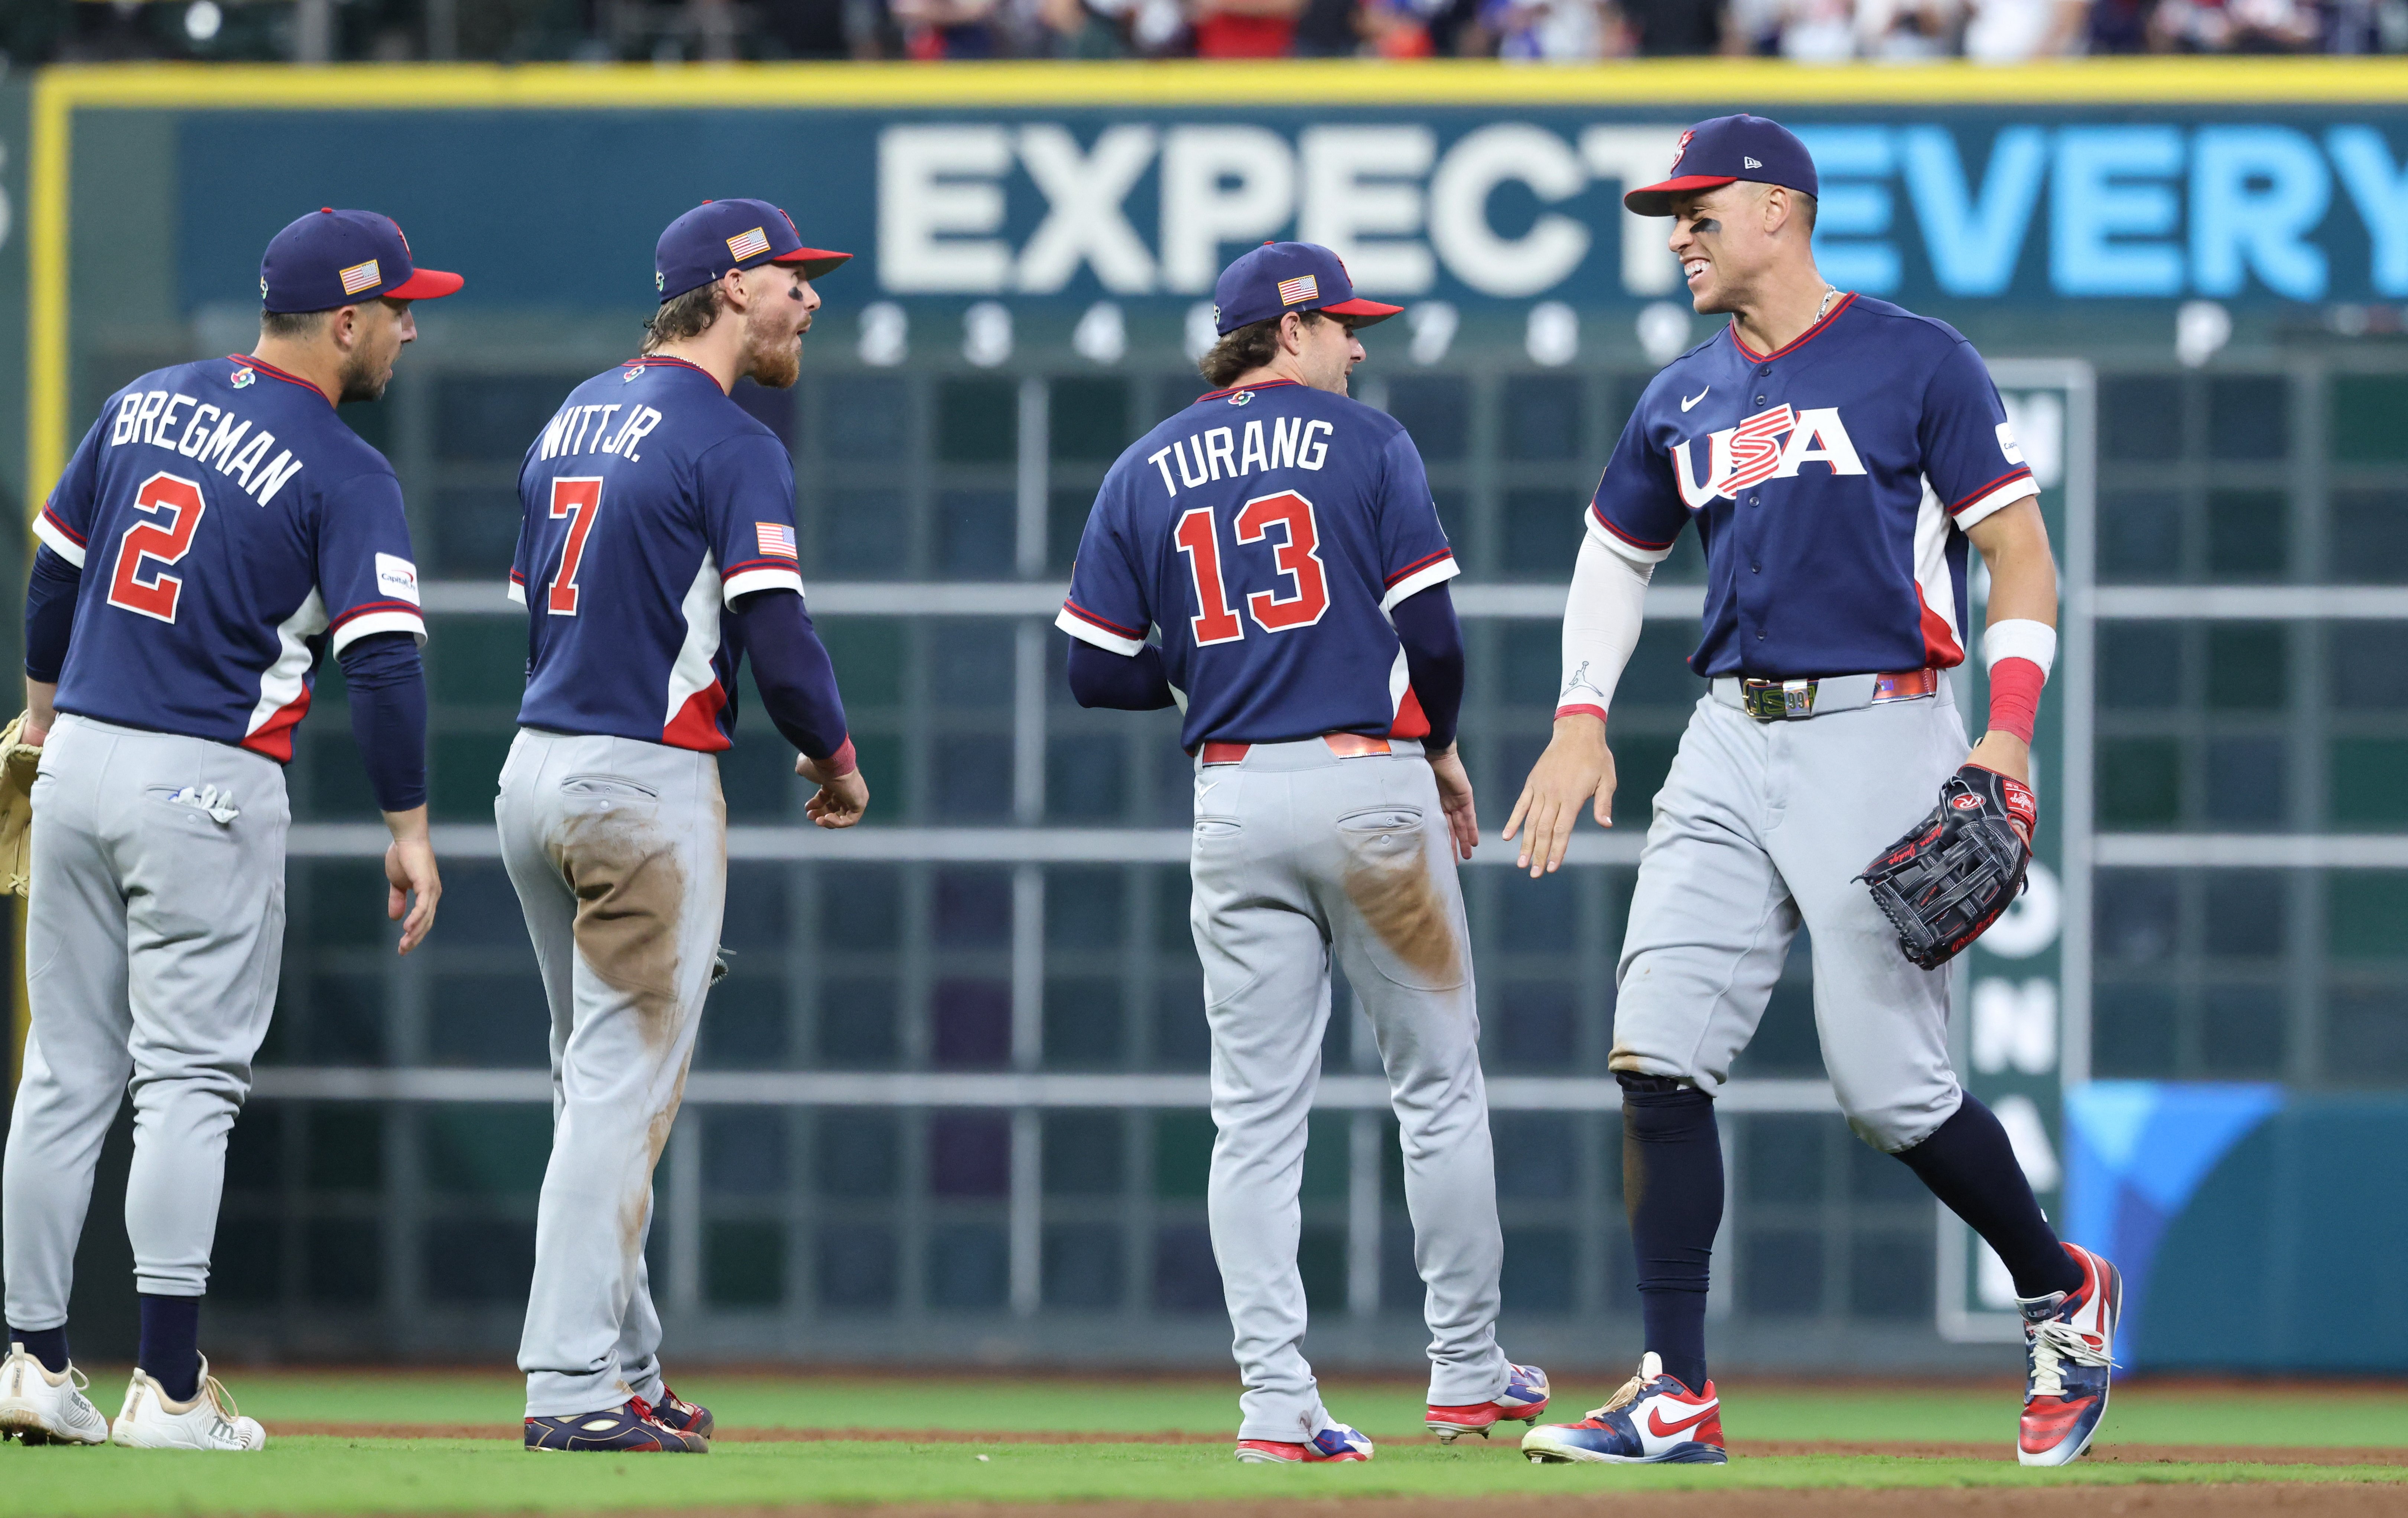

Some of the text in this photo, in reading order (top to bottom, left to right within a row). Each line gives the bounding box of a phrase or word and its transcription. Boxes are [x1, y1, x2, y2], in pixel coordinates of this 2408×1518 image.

[877, 122, 2408, 300] EXPECT EVERY
[111, 390, 303, 508] BREGMAN
[1148, 417, 1334, 498] TURANG
[1670, 402, 1868, 509] USA
[106, 470, 206, 625] 2
[548, 476, 603, 616] 7
[1173, 489, 1330, 647] 13
[1788, 691, 1805, 709] 99
[1888, 823, 1943, 864] Aaron Judge
[2010, 793, 2034, 813] Rawlings
[212, 1434, 241, 1446] marucci
